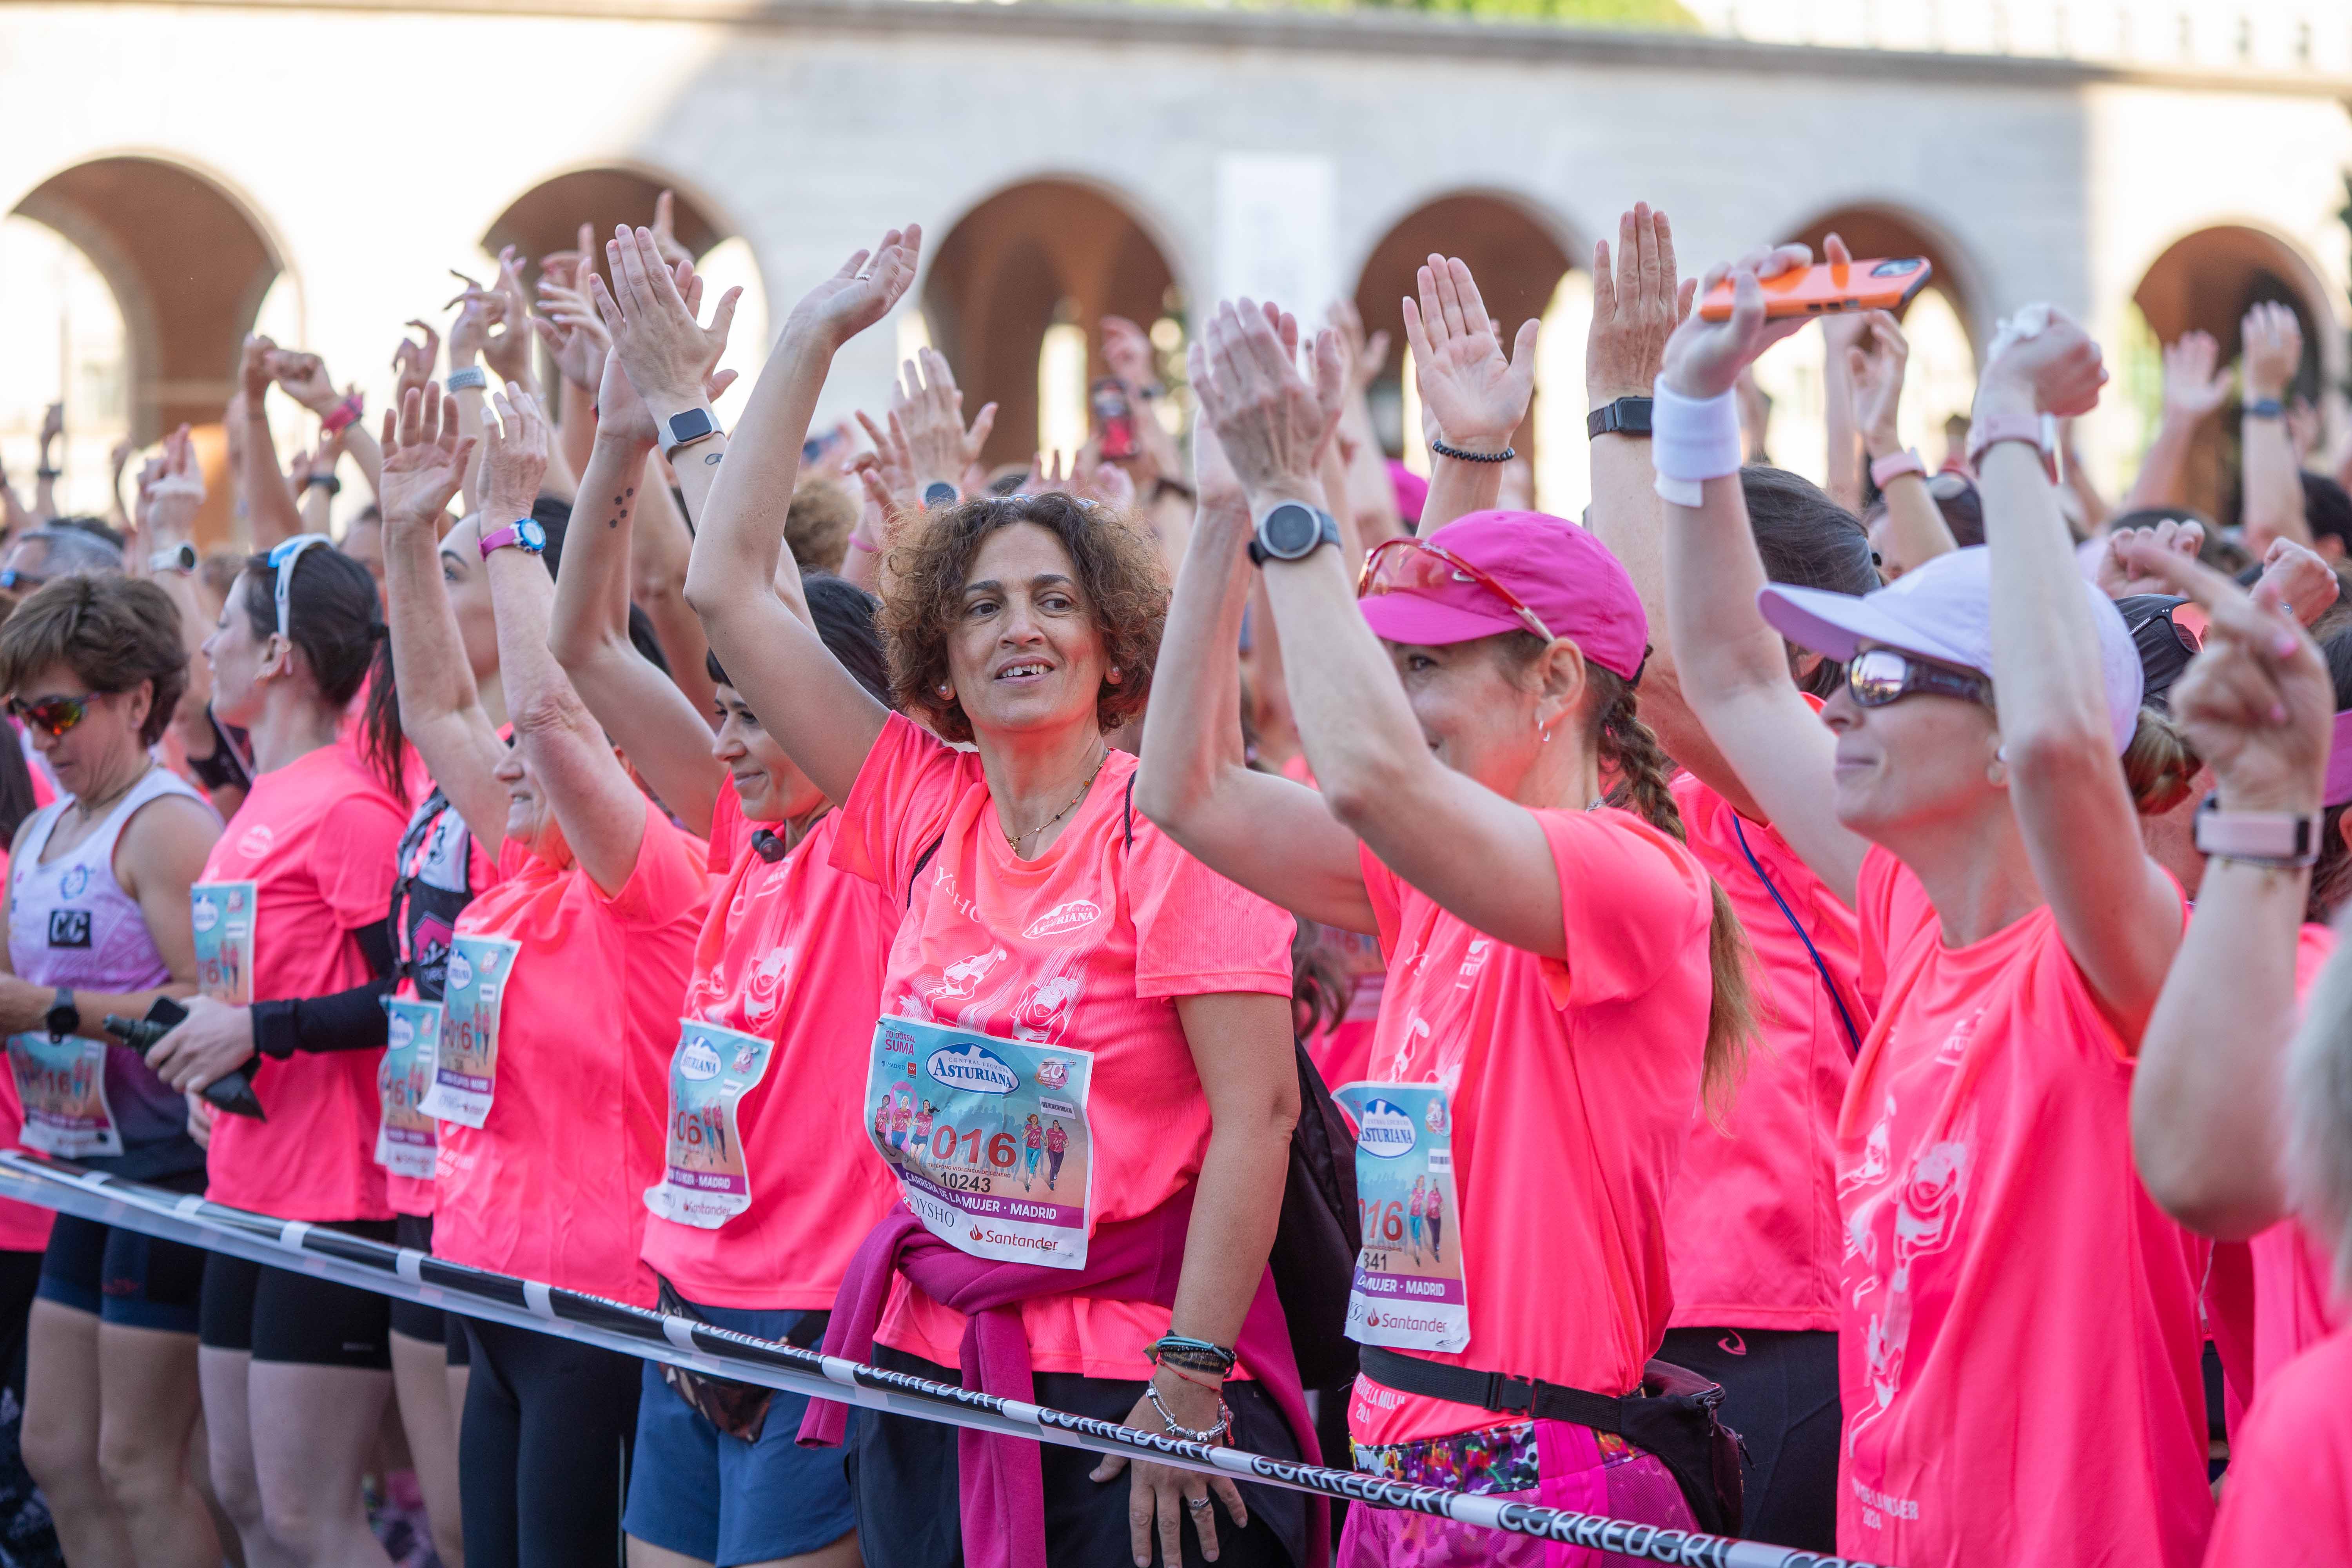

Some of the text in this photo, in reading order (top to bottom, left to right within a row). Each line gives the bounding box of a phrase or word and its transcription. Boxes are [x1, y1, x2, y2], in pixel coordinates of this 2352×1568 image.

[2129, 616, 2151, 636] NORTHWEEK
[885, 1039, 915, 1056] SUMA
[895, 1032, 916, 1043] DORSAL
[887, 1061, 906, 1071] MADRID
[933, 1057, 1014, 1088] ASTURIANA
[948, 1057, 1009, 1074] CENTRAL LECHERA
[931, 1125, 1017, 1168] 016
[941, 1171, 991, 1193] 10243
[906, 1172, 1057, 1220] CARRERA DE LA MUJER MADRID
[985, 1229, 1059, 1250] Santander
[1405, 1280, 1445, 1297] MADRID
[1381, 1312, 1447, 1333] Santander
